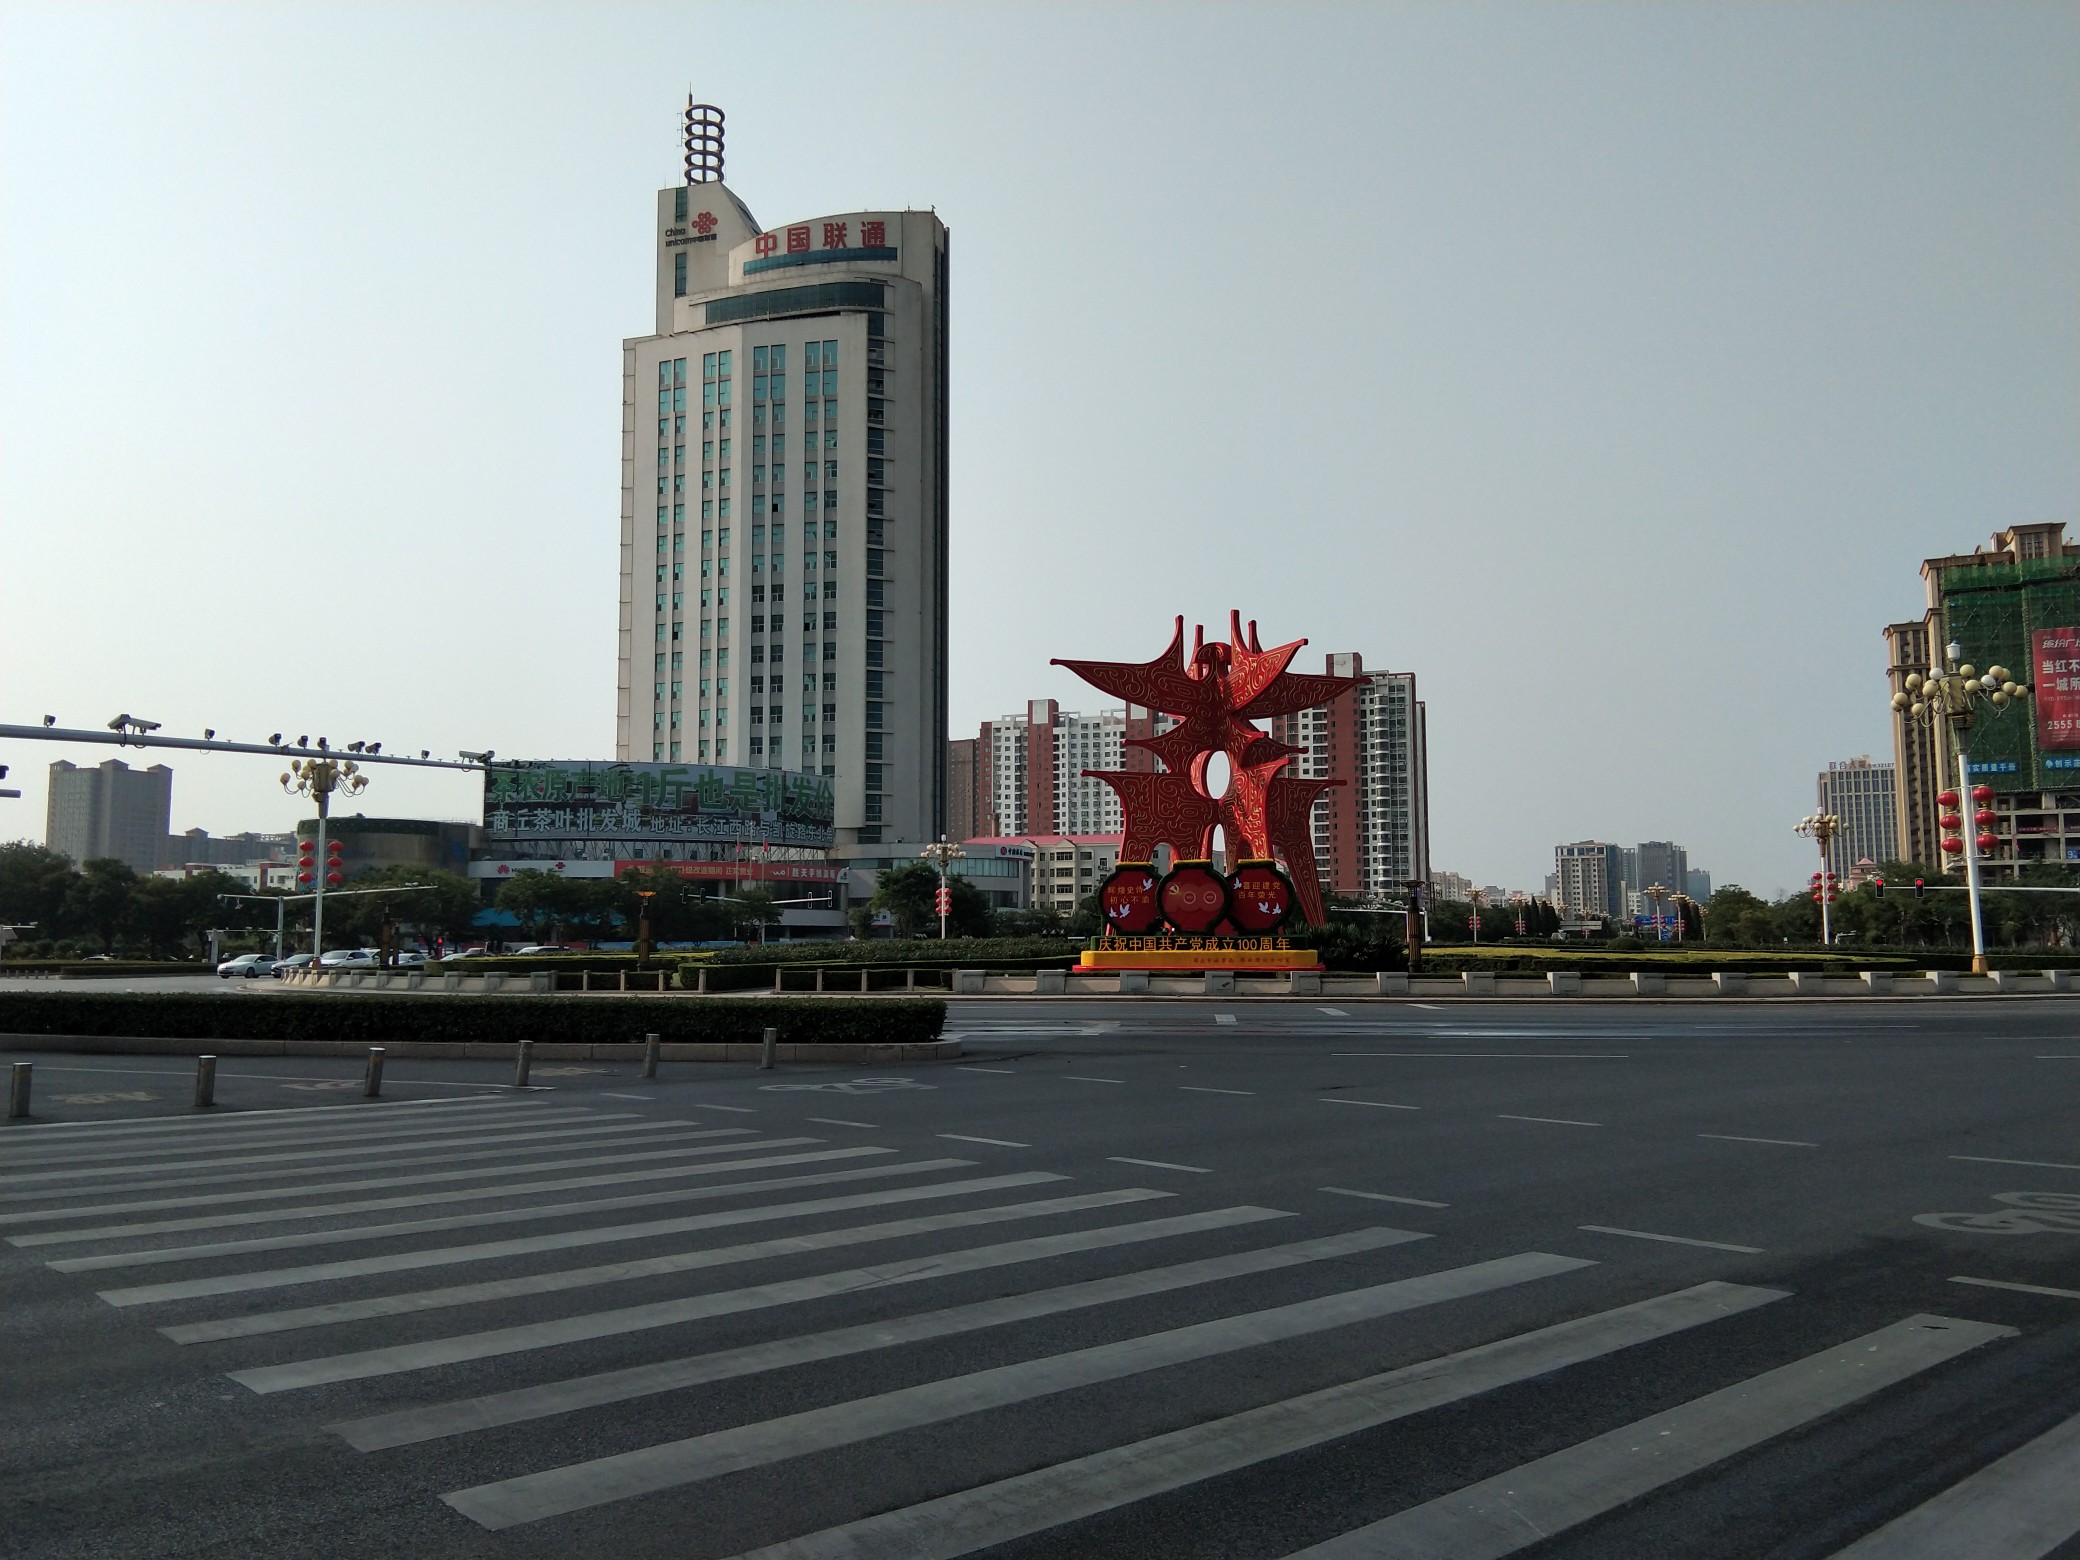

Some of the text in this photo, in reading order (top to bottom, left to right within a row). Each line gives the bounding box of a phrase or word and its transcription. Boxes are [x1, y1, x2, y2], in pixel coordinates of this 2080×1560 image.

[755, 221, 886, 259] 中国联通
[2042, 659, 2080, 674] 当红不
[2047, 720, 2073, 730] 2555
[491, 768, 834, 821] 茶农原产地1斤也是批发价
[493, 808, 643, 834] 商丘茶叶批发城
[1238, 890, 1277, 900] 百年荣光
[1098, 936, 1291, 951] 庆祝中国共产党成立100周年
